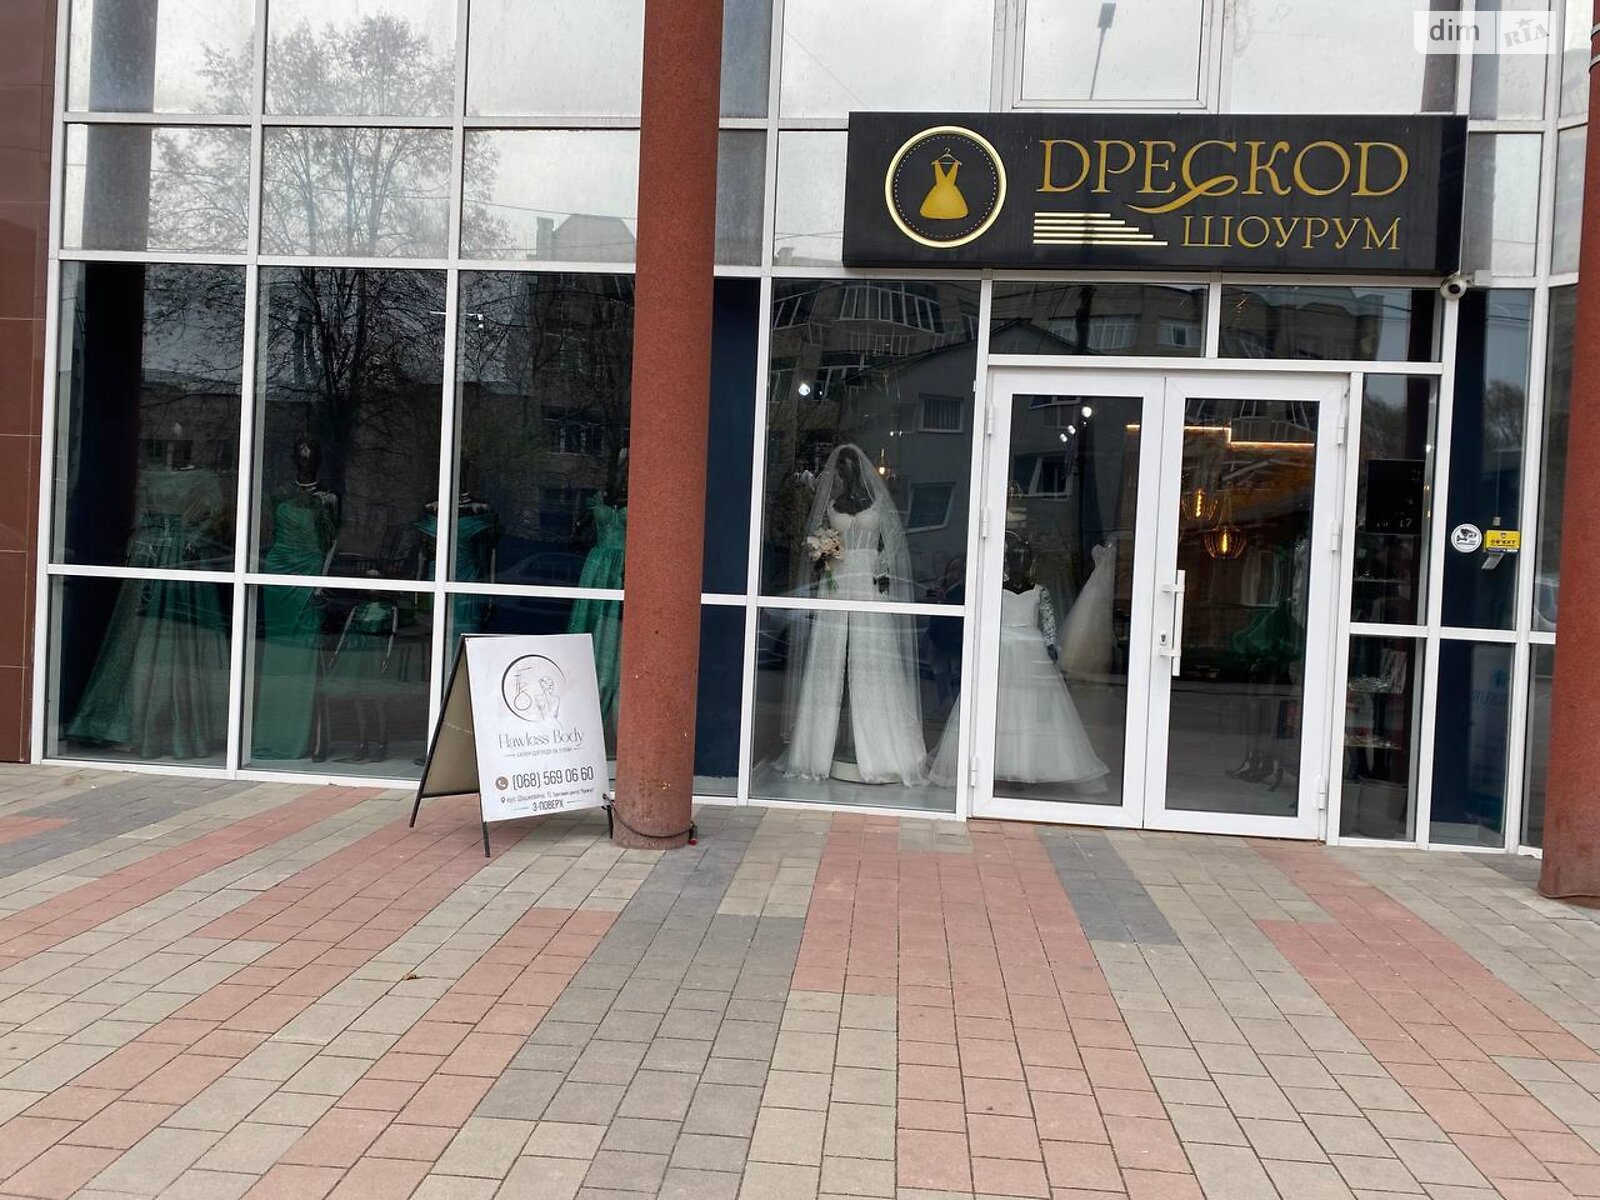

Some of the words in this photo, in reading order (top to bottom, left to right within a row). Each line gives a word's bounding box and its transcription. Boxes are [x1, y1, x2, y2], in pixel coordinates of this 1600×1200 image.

[1181, 214, 1401, 251] ШОУРУМ
[552, 727, 584, 747] Body
[512, 772, 541, 790] (068)
[543, 769, 563, 785] 569
[565, 768, 578, 783] 06
[580, 766, 594, 781] 60
